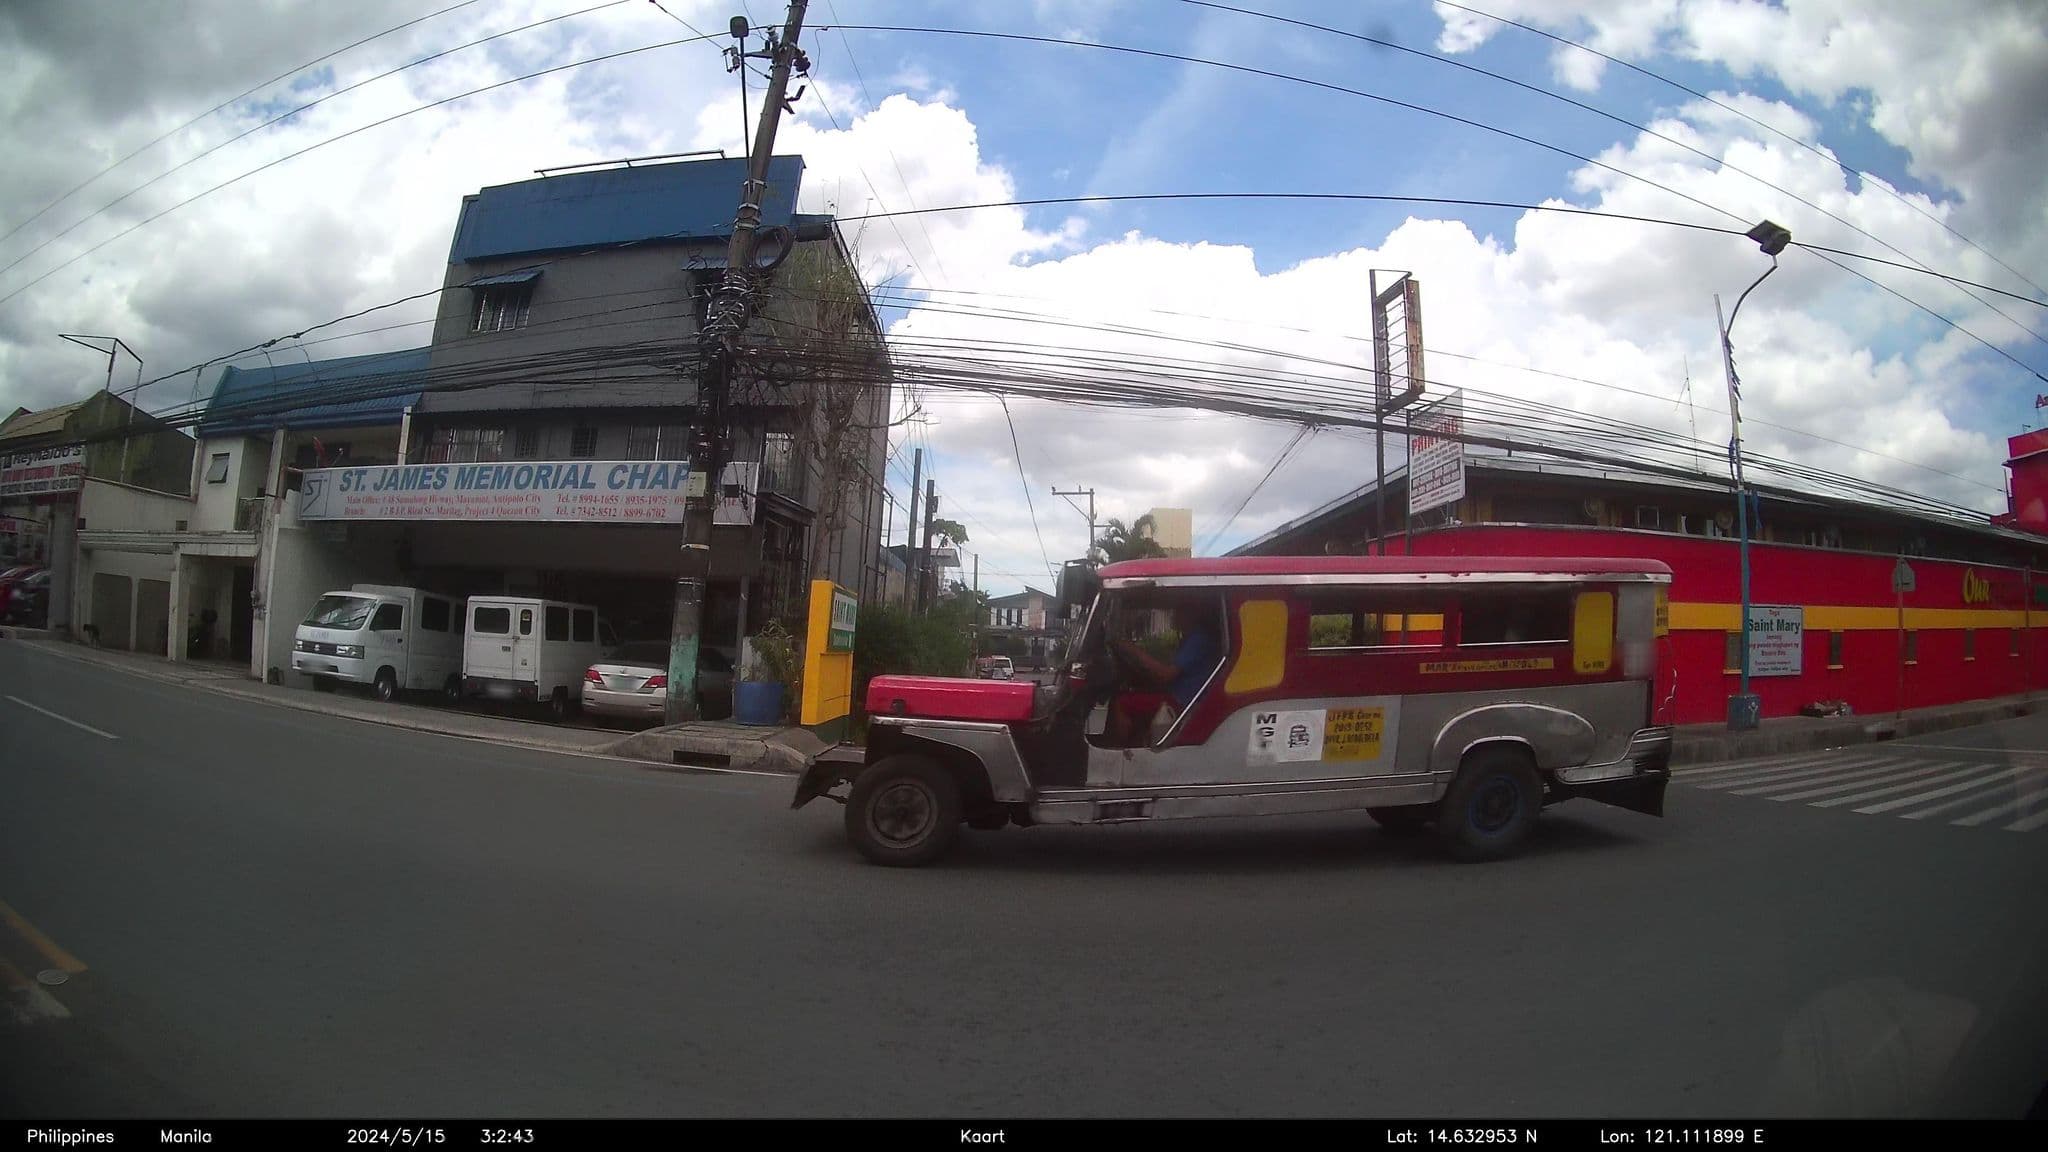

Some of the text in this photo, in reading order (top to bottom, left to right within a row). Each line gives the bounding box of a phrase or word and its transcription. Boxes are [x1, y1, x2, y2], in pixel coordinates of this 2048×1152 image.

[340, 468, 367, 491] ST.
[373, 466, 449, 491] JAMES
[454, 464, 596, 490] MEMORIAL
[607, 463, 689, 490] CHAP
[1748, 618, 1801, 634] Saint Mary
